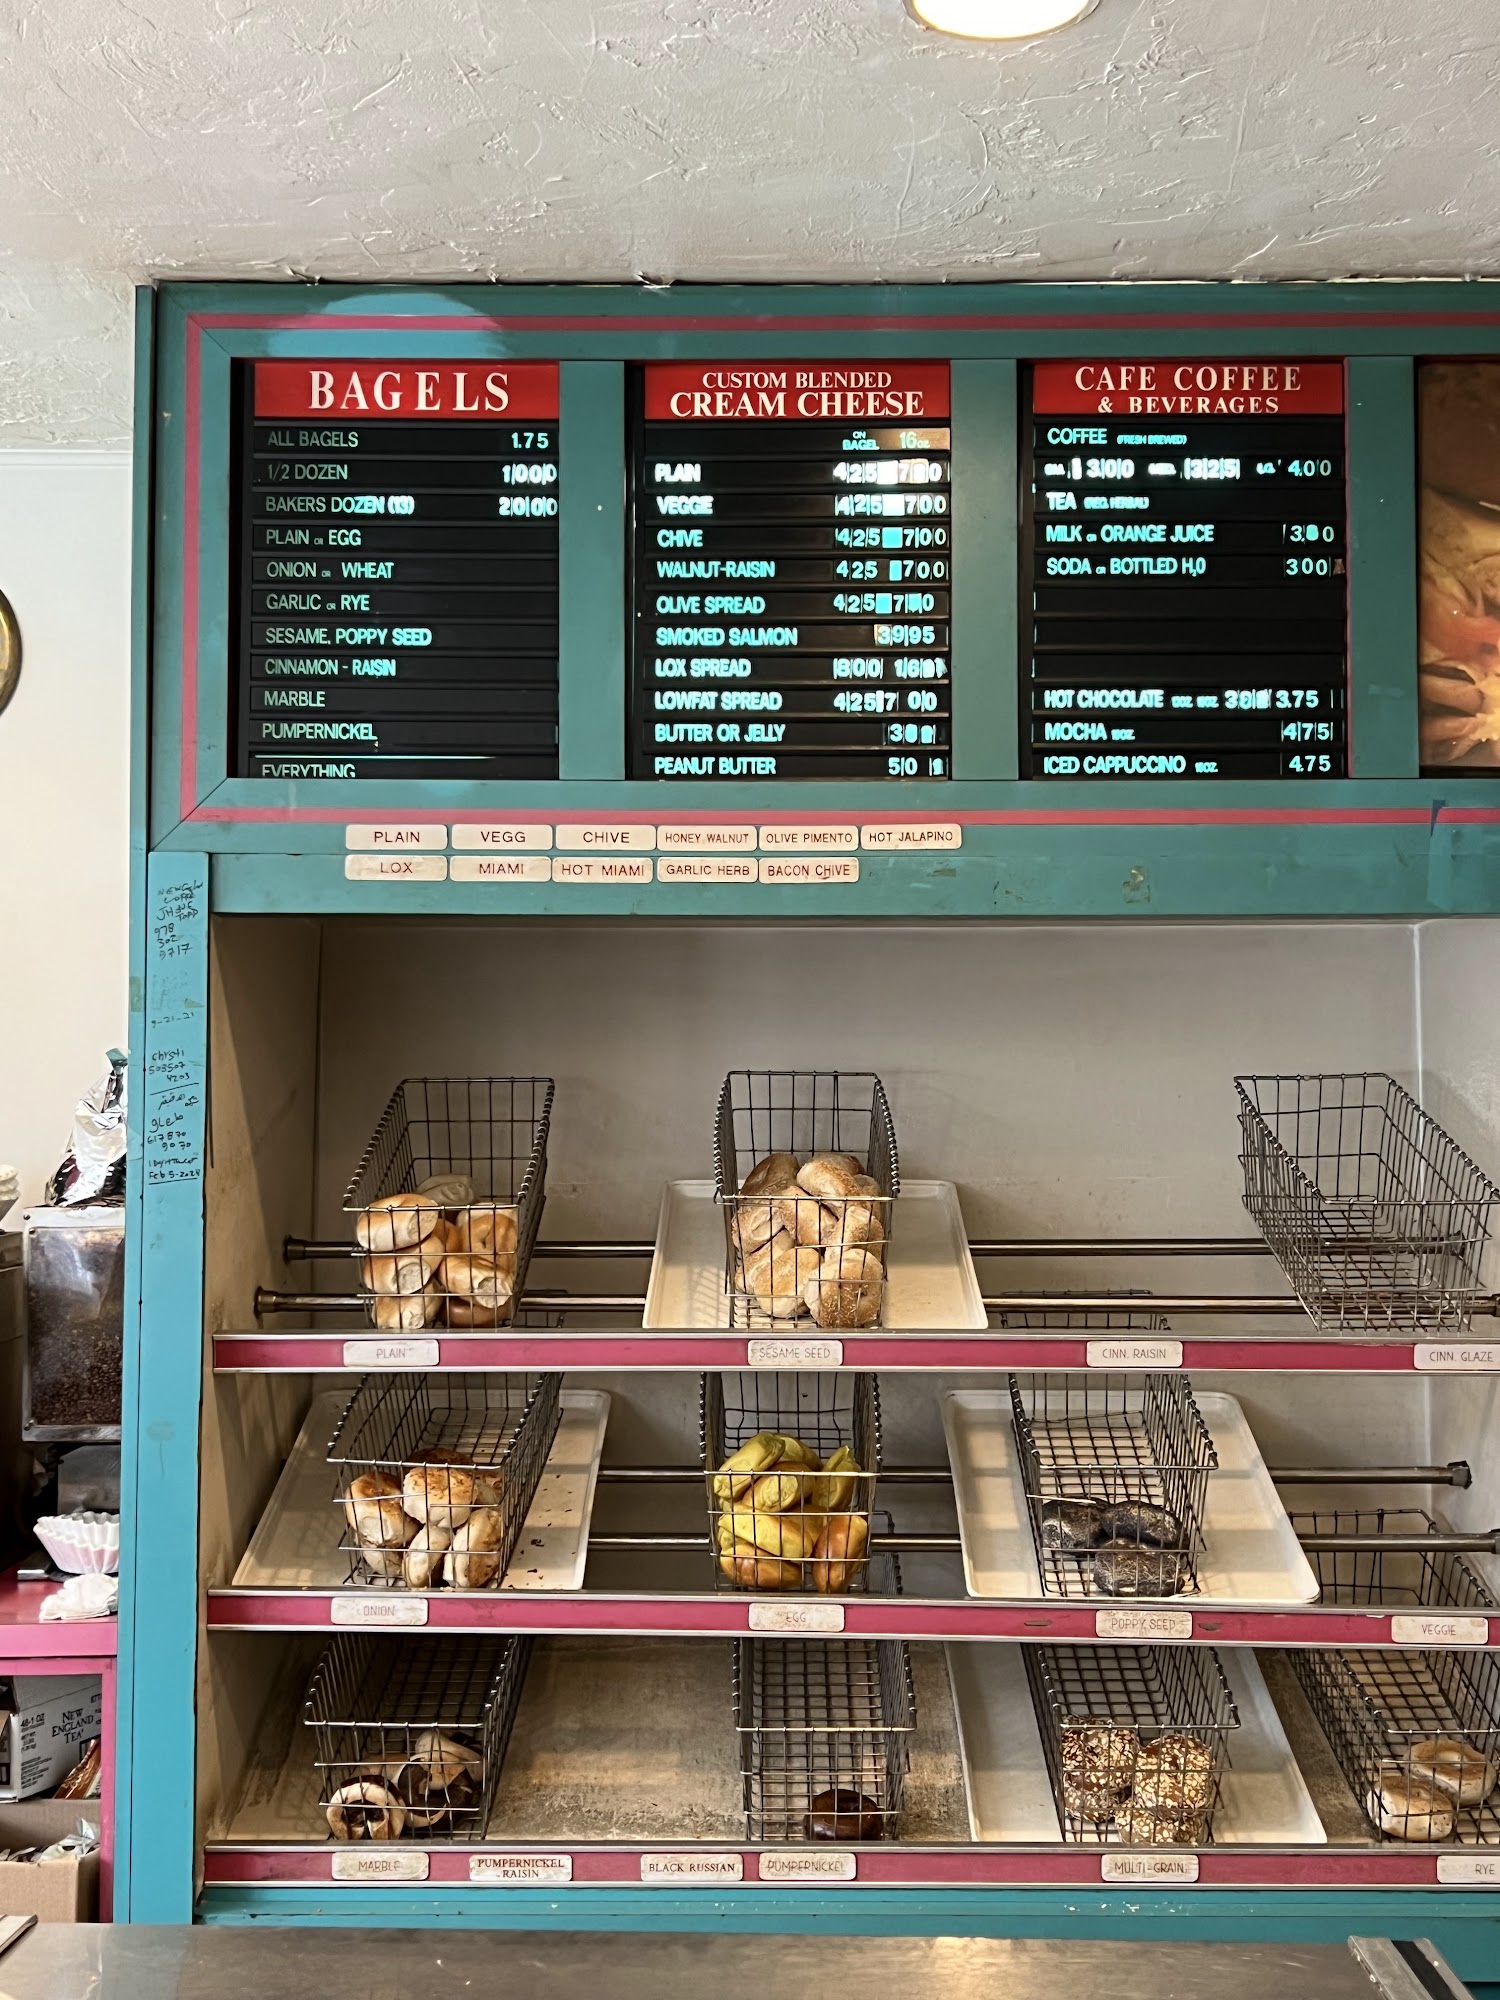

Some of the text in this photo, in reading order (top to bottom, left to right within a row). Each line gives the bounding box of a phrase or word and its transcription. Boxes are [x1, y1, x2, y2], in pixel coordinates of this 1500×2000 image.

[702, 371, 892, 389] CUSTOM BLENDED
[1075, 366, 1301, 391] CAFE COFFEE
[308, 370, 510, 412] BAGELS
[670, 391, 924, 417] CREAM CHEESE
[1098, 396, 1279, 413] & BEVERAGES
[268, 431, 549, 449] ALL BAGELS 1.75
[852, 431, 866, 439] ON
[1047, 428, 1107, 444] COFFEE
[842, 439, 880, 450] BAGEL
[268, 464, 290, 480] 1/2
[294, 464, 348, 480] DOZEN
[654, 463, 701, 482] PLAIN
[265, 497, 326, 513] BAKERS
[331, 496, 385, 514] DOZEN
[387, 495, 415, 514] (13)
[656, 495, 714, 515] VEGGIE
[1046, 492, 1077, 510] TEA
[266, 529, 309, 545] PLAIN
[328, 529, 361, 546] EGG
[657, 529, 703, 547] CHIVE
[1046, 525, 1083, 542] MILK
[1100, 525, 1167, 542] ORANGE
[1170, 524, 1214, 542] JUICE
[266, 562, 317, 579] ONION
[341, 562, 394, 579] WHEAT
[657, 561, 775, 578] WALNUT-RAISIN
[1046, 558, 1091, 575] SODA
[1110, 558, 1177, 575] BOTTLED
[266, 594, 370, 611] GARLIC OR RYE
[656, 596, 701, 613] OLIVE
[704, 596, 765, 613] SPREAD
[335, 628, 387, 645] POPPY
[391, 628, 432, 646] SEED
[656, 627, 725, 645] SMOKED
[729, 627, 798, 645] SALMON
[265, 659, 338, 675] CINNAMON
[352, 659, 396, 676] RAISIN
[655, 658, 687, 677] LOX
[690, 658, 751, 677] SPREAD
[264, 691, 325, 707] MARBLE
[654, 691, 718, 710] LOWFAT
[721, 691, 782, 710] SPREAD
[1044, 689, 1074, 708] HOT
[1077, 689, 1164, 708] CHOCOLATE
[262, 723, 377, 740] PUMPERNICKEL
[654, 724, 712, 742] BUTTER
[716, 724, 740, 742] OR
[744, 724, 786, 741] JELLY
[1044, 722, 1107, 740] MOCHA
[262, 764, 355, 777] EVERYTHING
[654, 757, 776, 775] PEANUT BUTTER
[1044, 756, 1079, 774] ICED
[1083, 756, 1186, 774] CAPPUCCINO
[373, 831, 420, 843] PLAIN
[481, 831, 526, 843] VEGG
[583, 831, 630, 843] CHIVE
[665, 832, 749, 844] HONEY WALNUT
[766, 833, 853, 843] OLIVE PIMENTO
[869, 831, 953, 842] HOT JALAPINO
[380, 862, 413, 873] LOX
[479, 863, 524, 875] MIAMI
[562, 864, 645, 876] HOT MIAMI
[666, 864, 750, 875] GARLIC HERB
[767, 864, 850, 877] BACON CHIVE
[376, 1348, 406, 1359] PLAIN
[759, 1348, 831, 1358] SESAME SEED
[1133, 1349, 1166, 1359] RAISIN
[1461, 1352, 1493, 1362] GLAZE
[363, 1605, 395, 1616] ONION
[786, 1612, 806, 1622] EGG
[1111, 1618, 1176, 1630] POPPY SEED
[1421, 1624, 1457, 1636] VEGGIE
[62, 1708, 83, 1723] NEW
[52, 1715, 94, 1737] ENGLAND
[358, 1861, 400, 1872] MARBLE
[477, 1859, 565, 1868] PUMPERNICKEL
[649, 1863, 735, 1872] BLACK RUSSIAN
[767, 1860, 846, 1872] PUMPERNICKEL
[1114, 1862, 1184, 1874] MULTI-GRAIN
[1475, 1864, 1495, 1874] RYE
[502, 1869, 539, 1878] RAISIN
